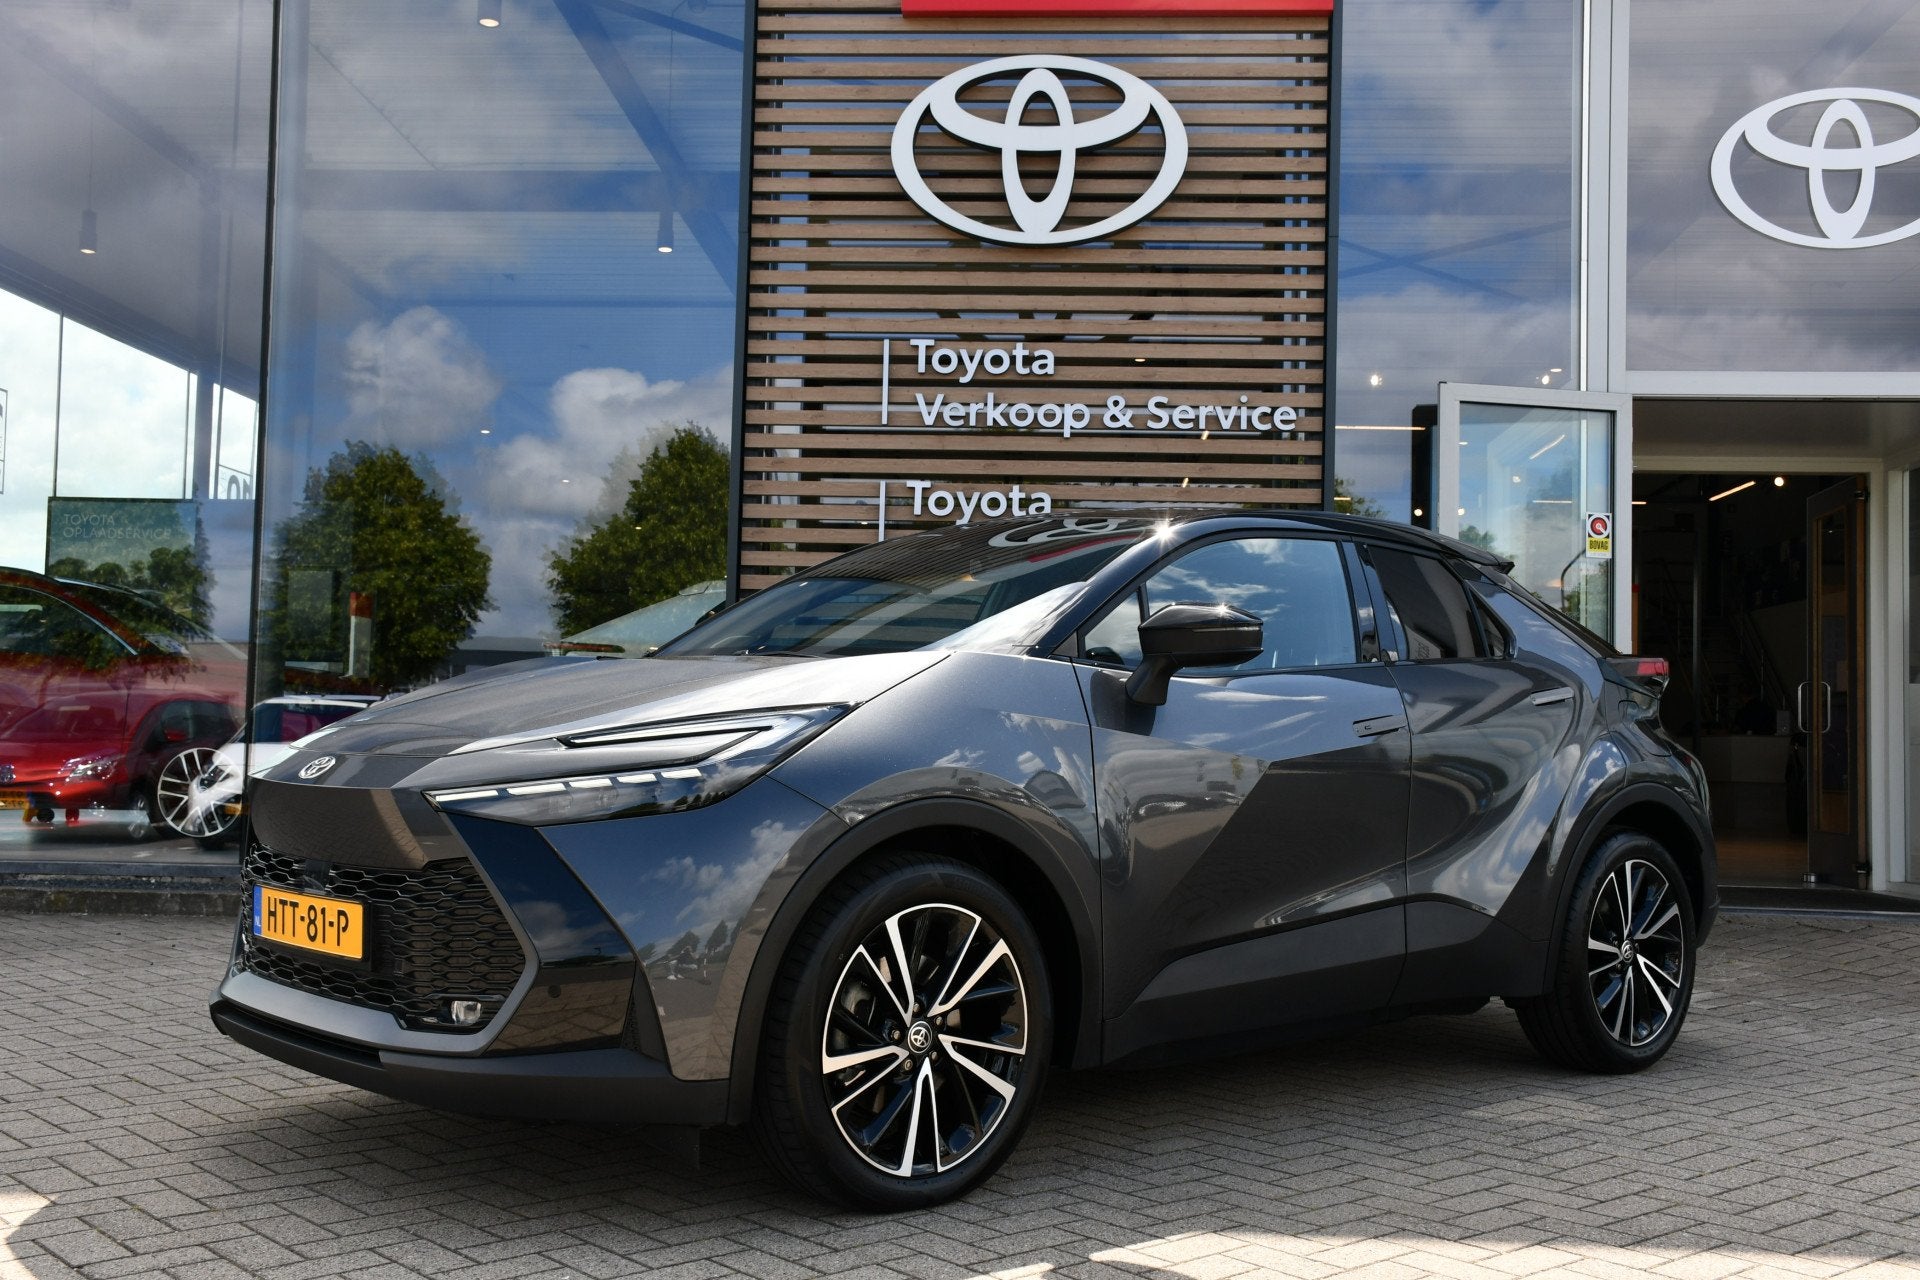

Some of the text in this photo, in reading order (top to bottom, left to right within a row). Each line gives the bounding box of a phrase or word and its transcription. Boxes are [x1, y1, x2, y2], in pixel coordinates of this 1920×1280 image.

[910, 339, 1055, 383] Toyota
[916, 392, 1297, 437] Verkoop & Service
[63, 514, 115, 526] TOYOTA
[907, 481, 1053, 524] Toyota
[63, 527, 172, 539] OPLAADSERVICE
[1589, 540, 1609, 550] BOVAG
[254, 896, 349, 946] NL HTT-81-P
